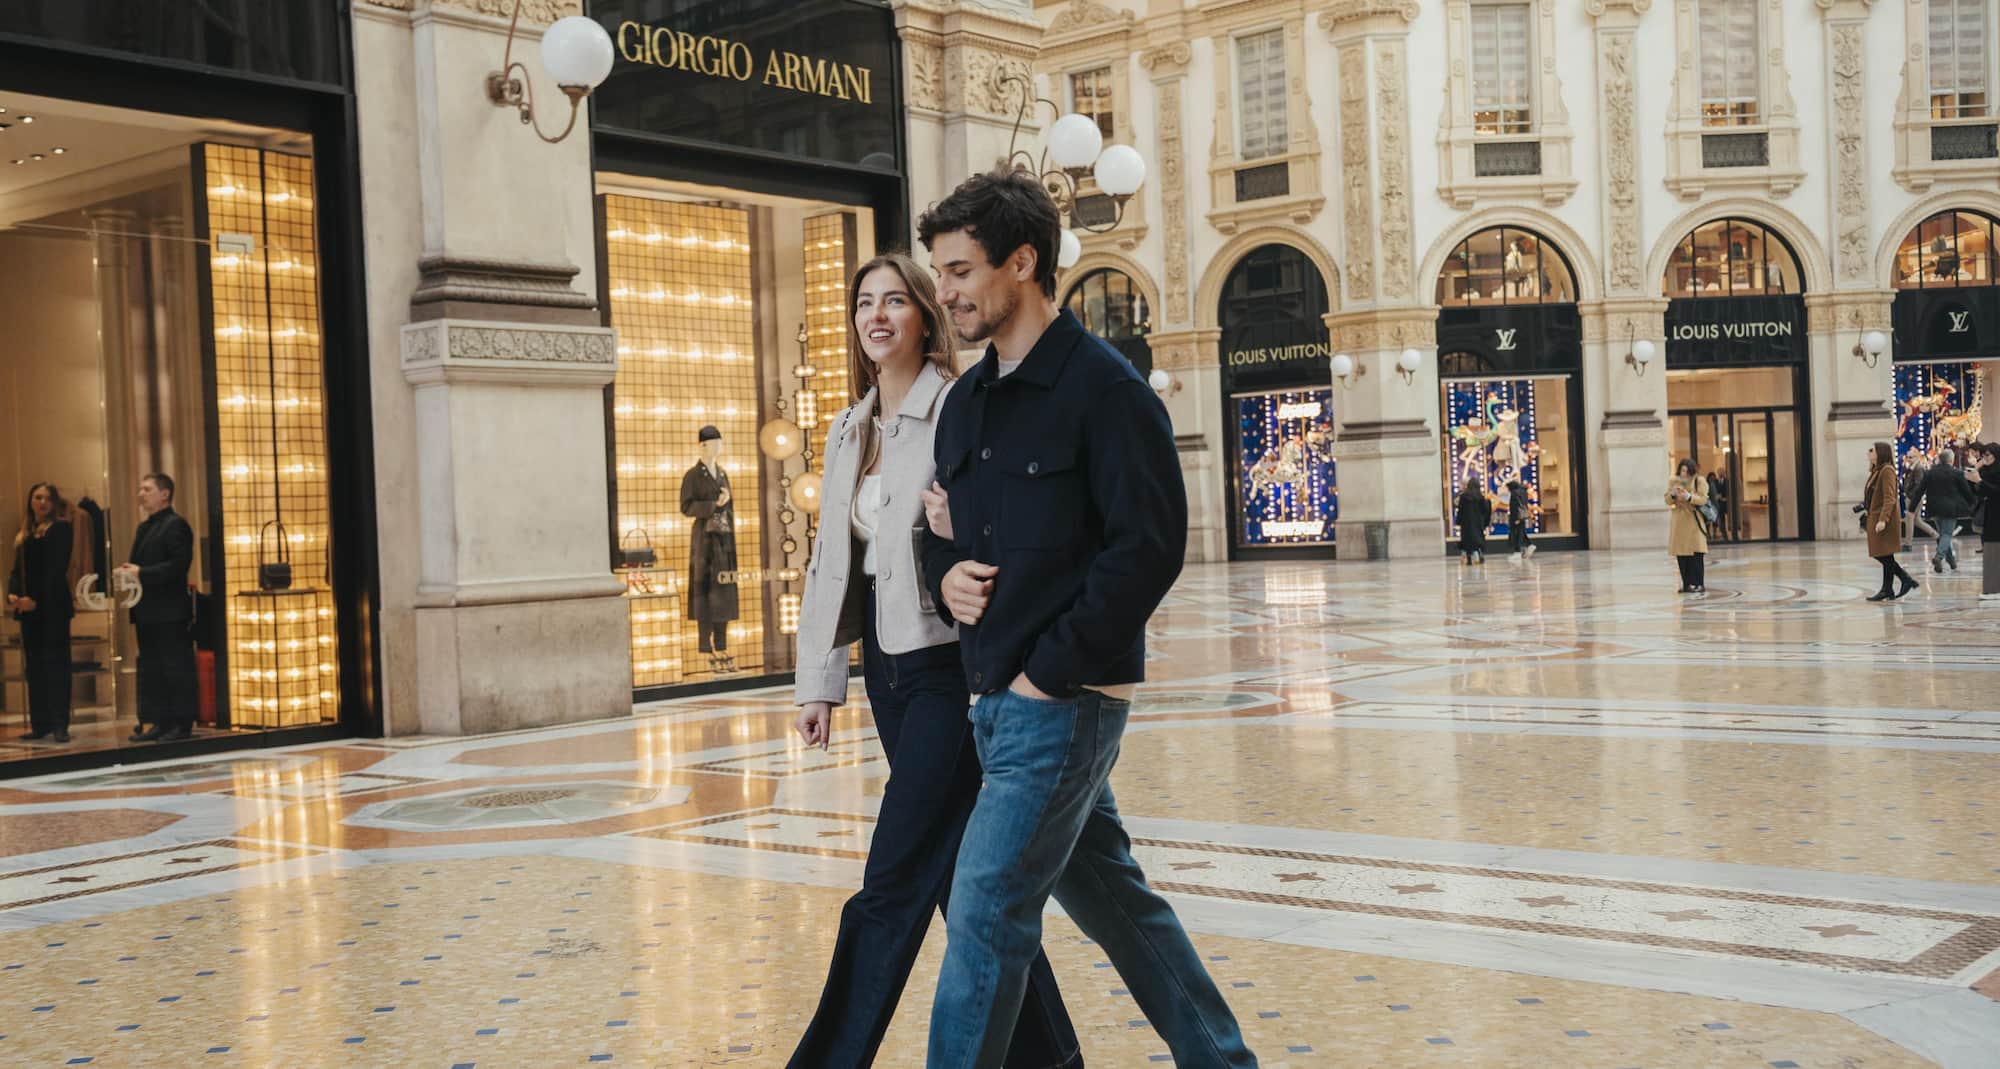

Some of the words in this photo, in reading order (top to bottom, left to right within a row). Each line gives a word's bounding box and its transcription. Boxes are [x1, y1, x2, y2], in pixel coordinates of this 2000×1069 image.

[617, 20, 753, 81] GIORGIO
[762, 49, 872, 104] ARMANI
[1673, 324, 1719, 340] LOUIS
[1722, 321, 1792, 339] VUITTON
[1228, 348, 1267, 366] LOUIS
[1270, 342, 1329, 361] VUITTON
